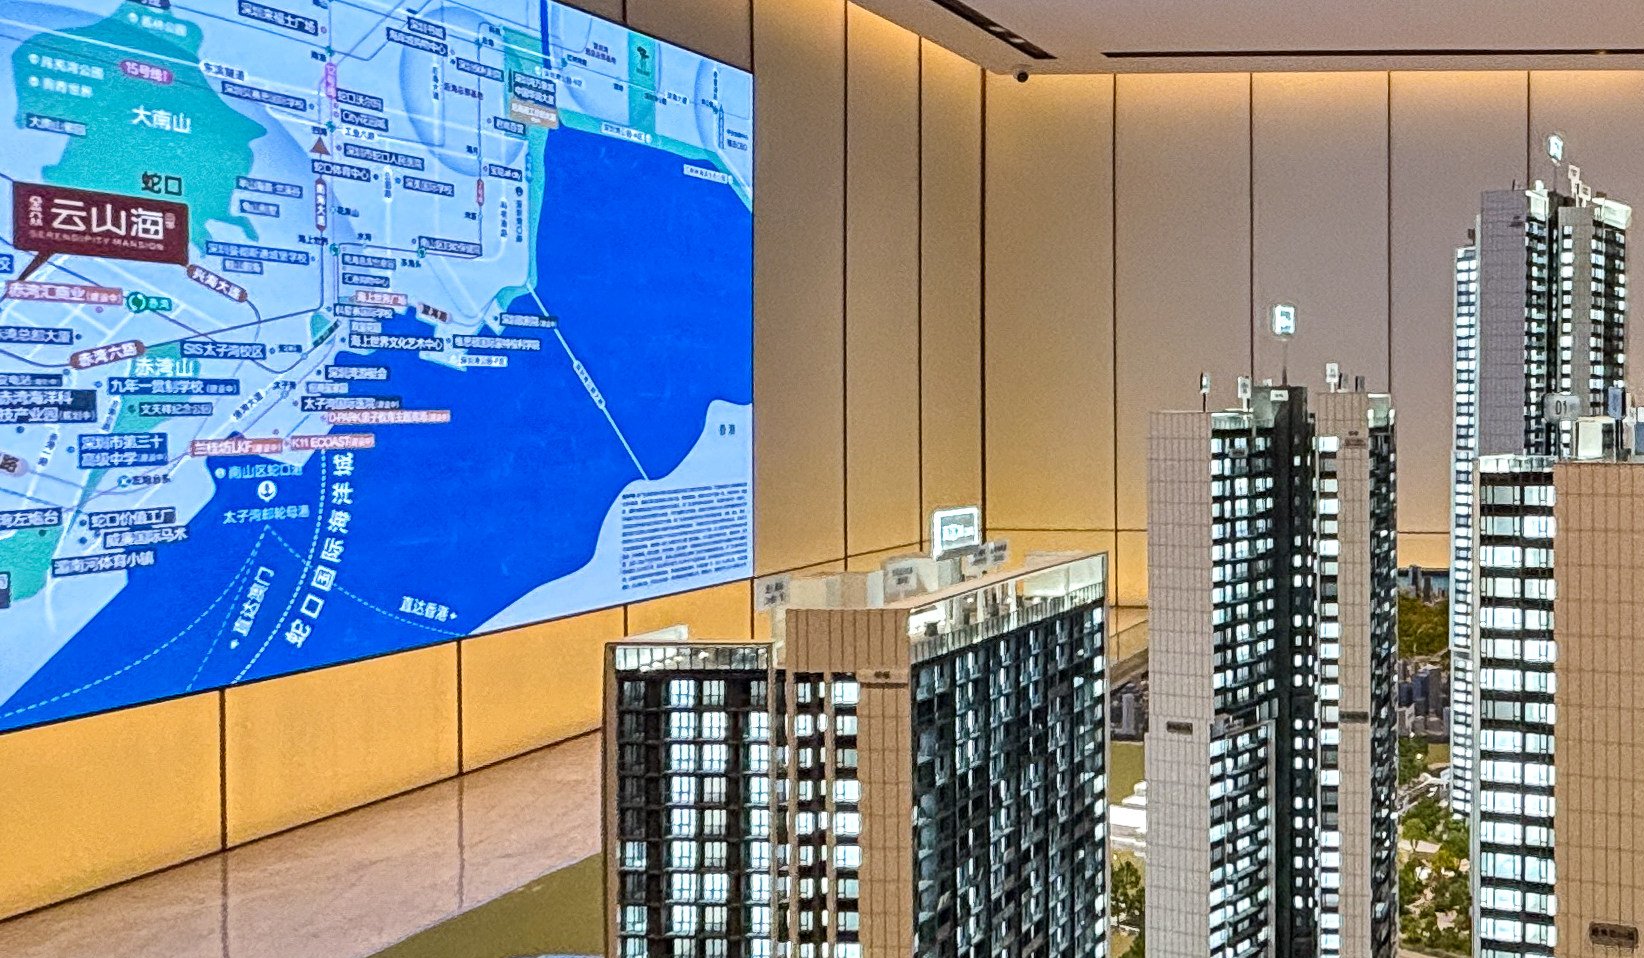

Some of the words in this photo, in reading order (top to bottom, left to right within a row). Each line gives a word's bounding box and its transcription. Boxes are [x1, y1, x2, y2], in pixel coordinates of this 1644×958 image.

[131, 104, 192, 134] 大南山
[141, 171, 182, 196] 蛇口
[50, 198, 165, 240] 云山海
[112, 238, 165, 251] MANSION
[284, 452, 355, 648] 蛇口国际海洋城
